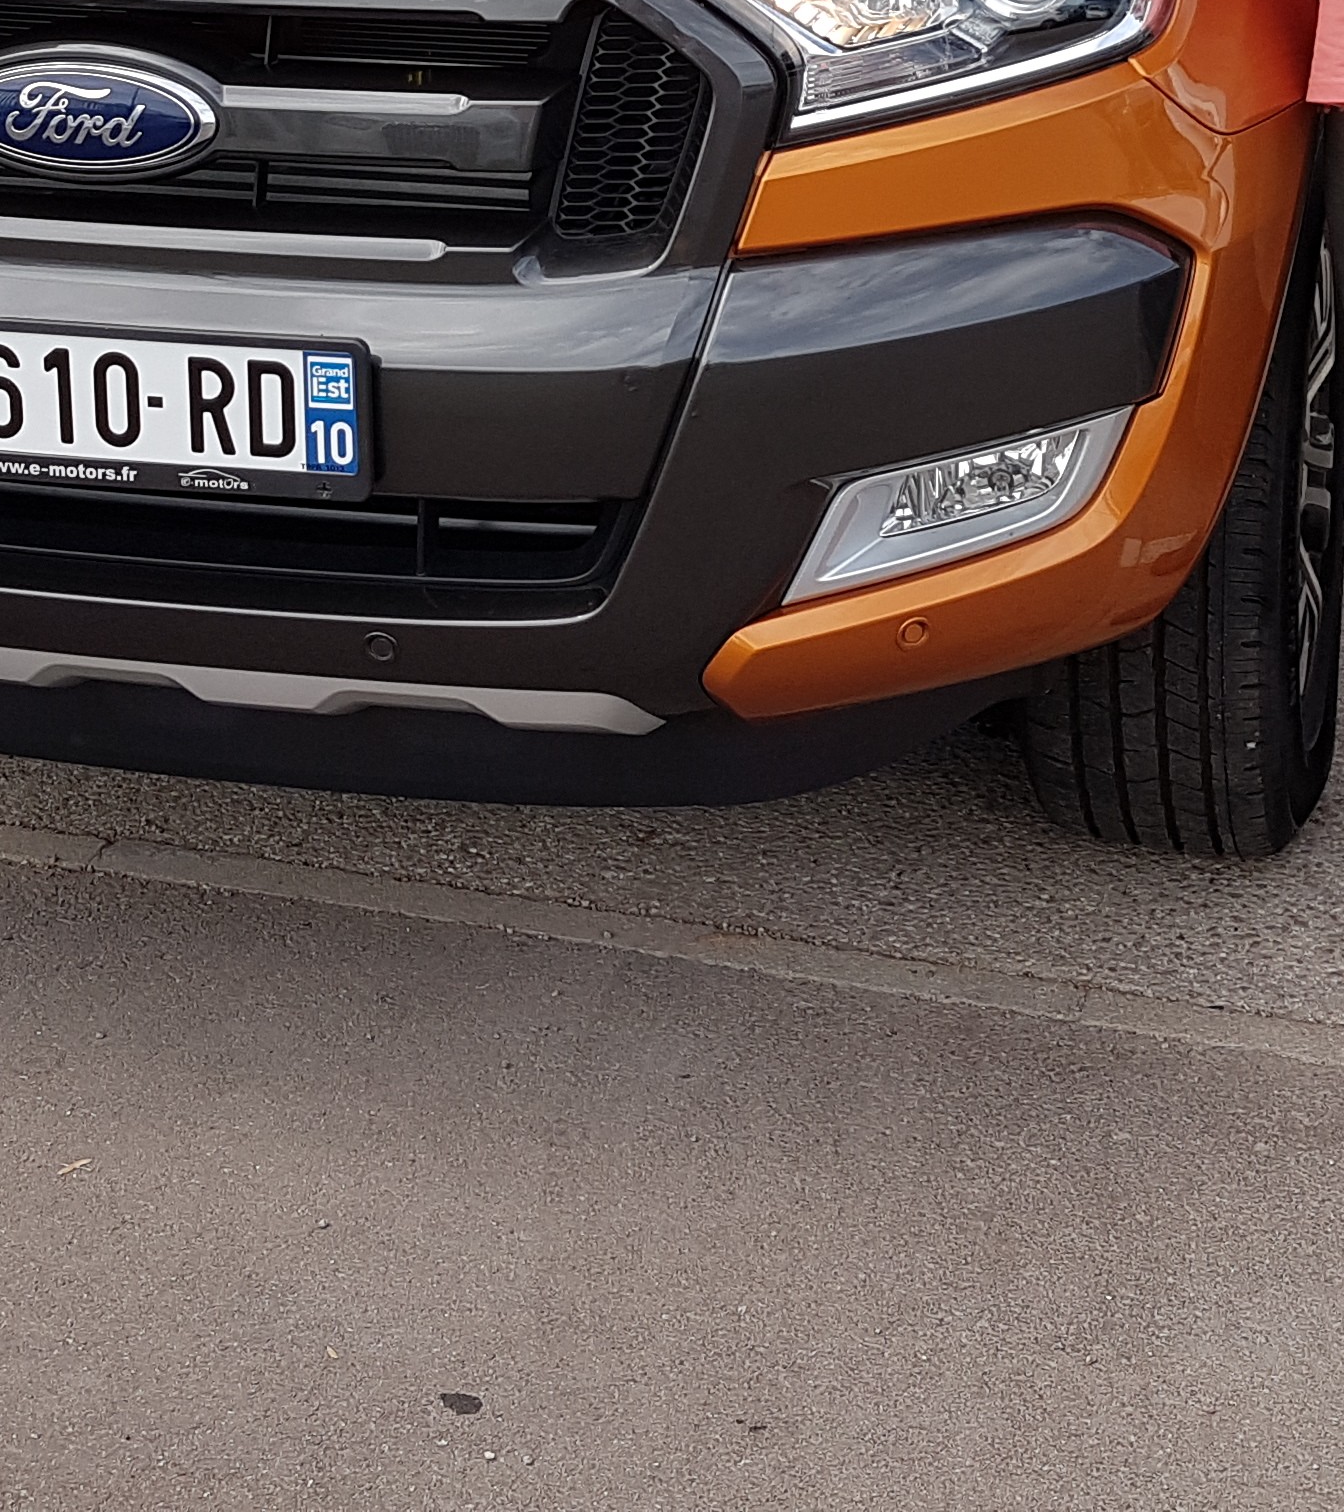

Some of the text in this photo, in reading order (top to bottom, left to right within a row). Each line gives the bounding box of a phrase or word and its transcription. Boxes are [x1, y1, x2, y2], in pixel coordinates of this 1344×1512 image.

[6, 81, 146, 148] Ford
[312, 365, 349, 378] Grand
[312, 376, 349, 399] Est
[310, 419, 354, 466] 10
